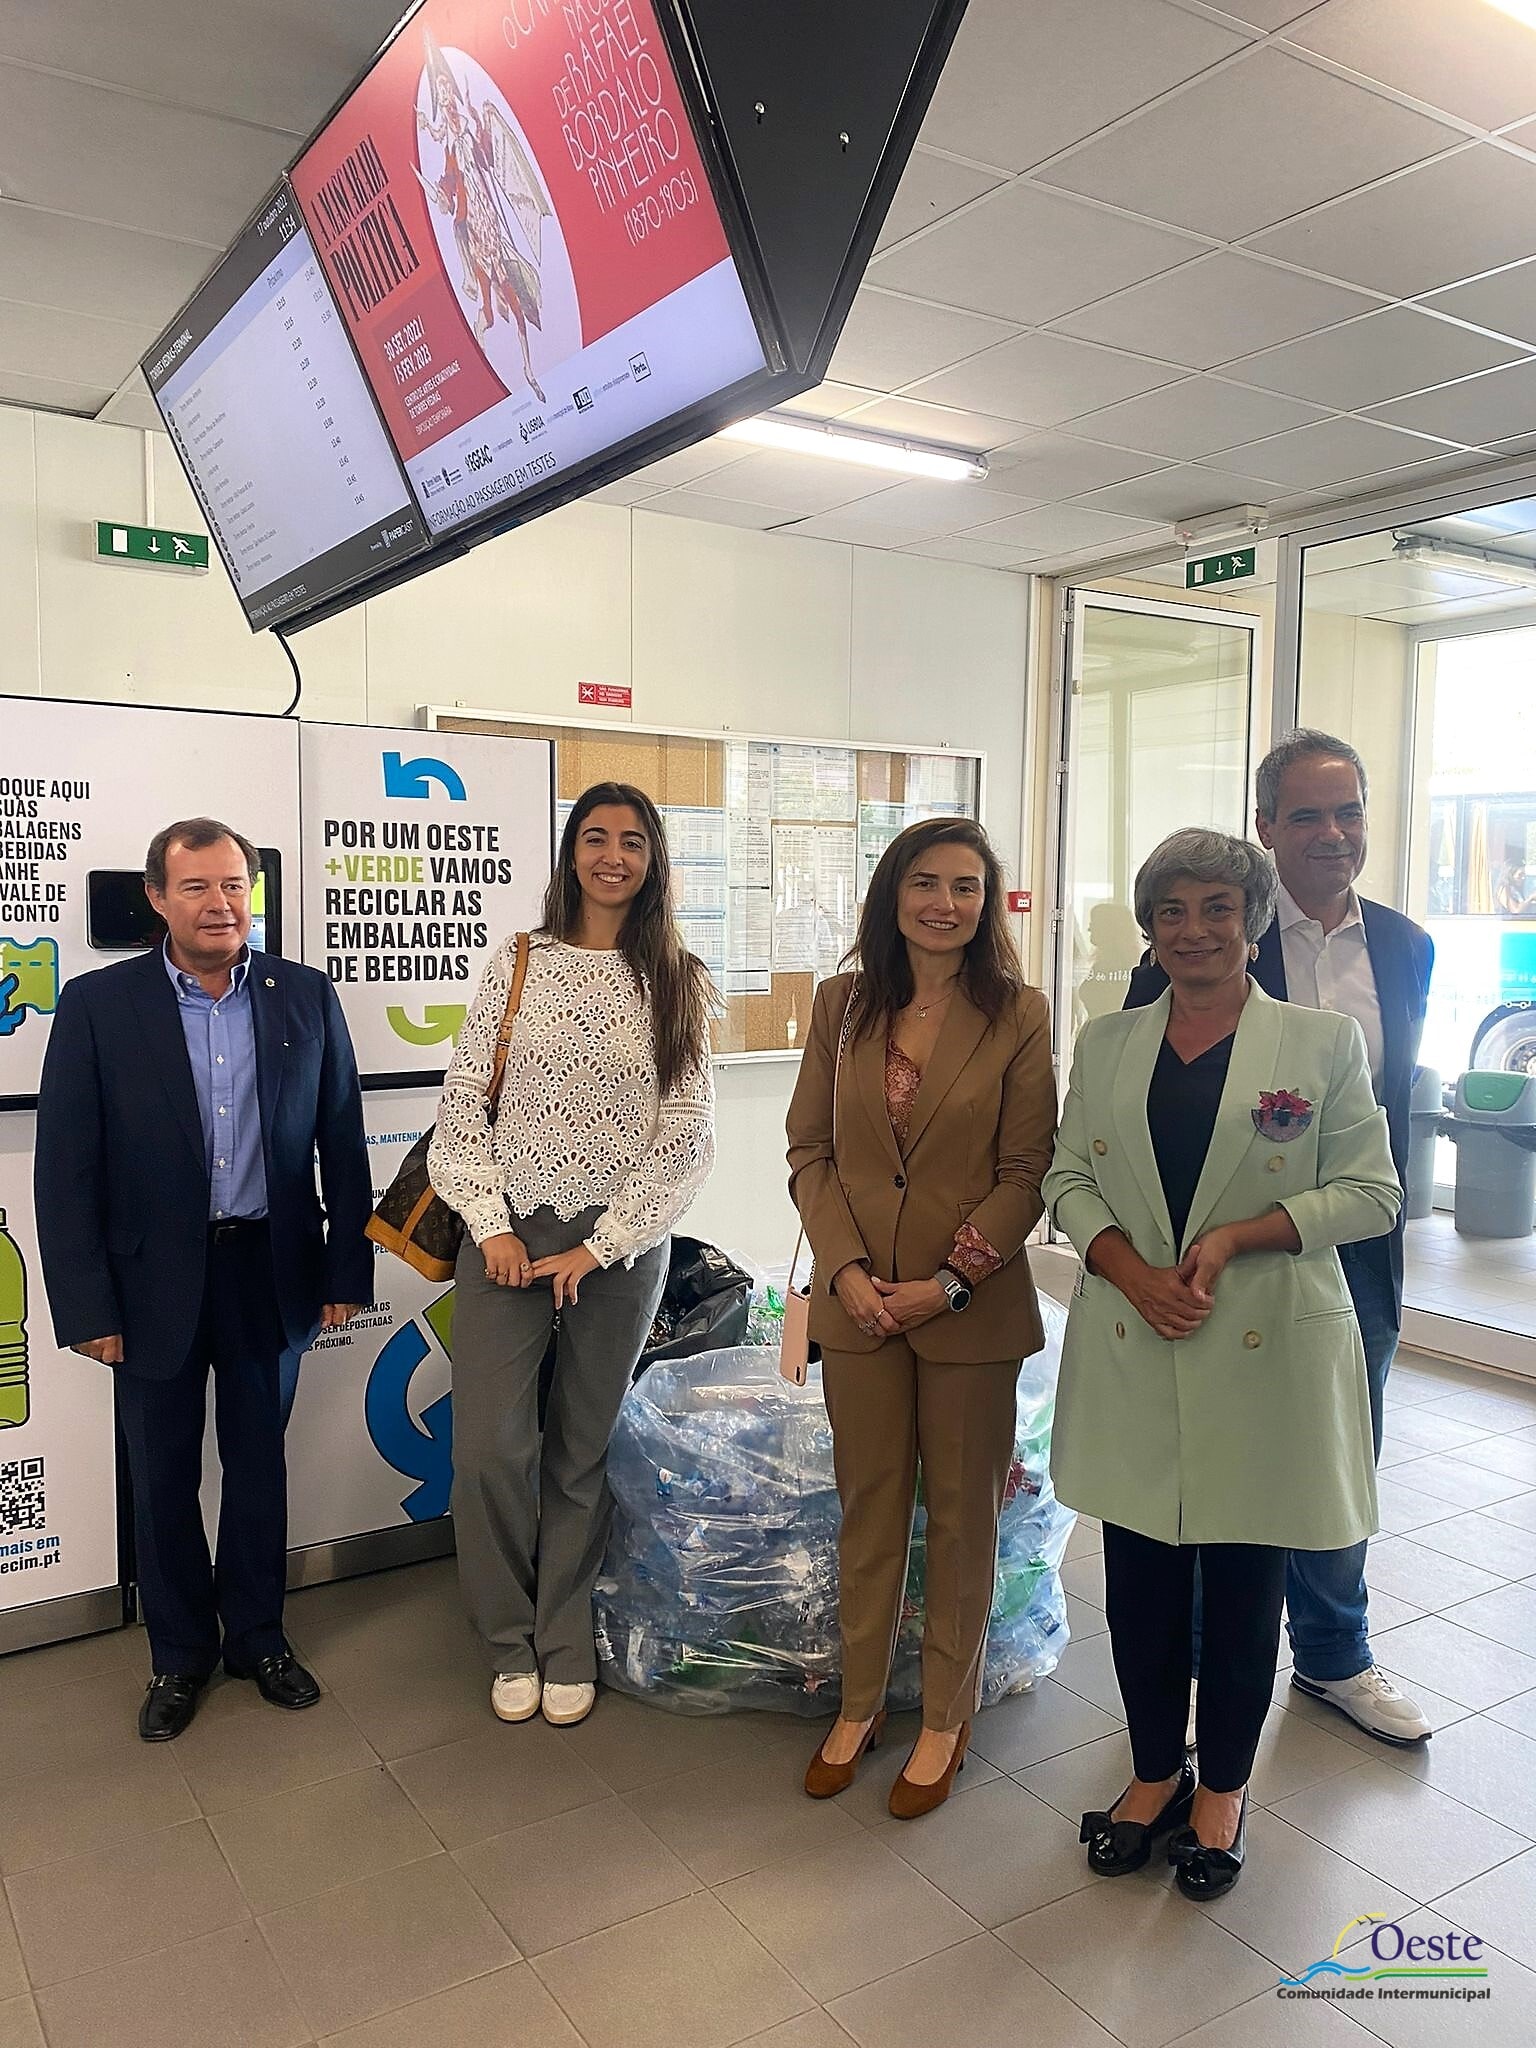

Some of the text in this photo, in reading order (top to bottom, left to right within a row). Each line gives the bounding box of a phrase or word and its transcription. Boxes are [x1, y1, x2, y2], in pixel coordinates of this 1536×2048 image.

[564, 0, 648, 103] RAFAEL
[552, 76, 577, 119] DE
[562, 53, 662, 171] BORDALO
[588, 109, 679, 214] PINHEIRO
[315, 130, 390, 241] MASCARADA
[274, 191, 289, 215] 2022
[624, 168, 699, 247] (1870-1905)
[277, 210, 297, 243] 11:34
[382, 338, 396, 362] 30
[389, 328, 408, 356] SET.
[401, 316, 423, 347] 2022
[399, 352, 418, 380] FEV.
[411, 340, 433, 371] 2023
[462, 491, 478, 511] AO
[472, 471, 518, 506] PASSAGEIRO
[513, 464, 529, 485] EM
[524, 449, 558, 478] TESTES
[50, 780, 90, 802] AQUI
[0, 799, 38, 818] UAS
[0, 820, 82, 841] ALAGENS
[324, 820, 500, 852] POR UM OESTE
[324, 855, 512, 885] +VERDE VAMOS
[45, 884, 67, 902] DE
[325, 888, 482, 916] RECICLAR AS
[325, 922, 488, 949] EMBALAGENS
[326, 955, 470, 983] DE BEBIDAS
[380, 1301, 390, 1312] OS
[339, 1315, 393, 1332] DEPOSITADAS
[315, 1335, 354, 1351] PRÓXIMO.
[36, 1535, 60, 1549] em
[0, 1549, 61, 1574] ecim.pt
